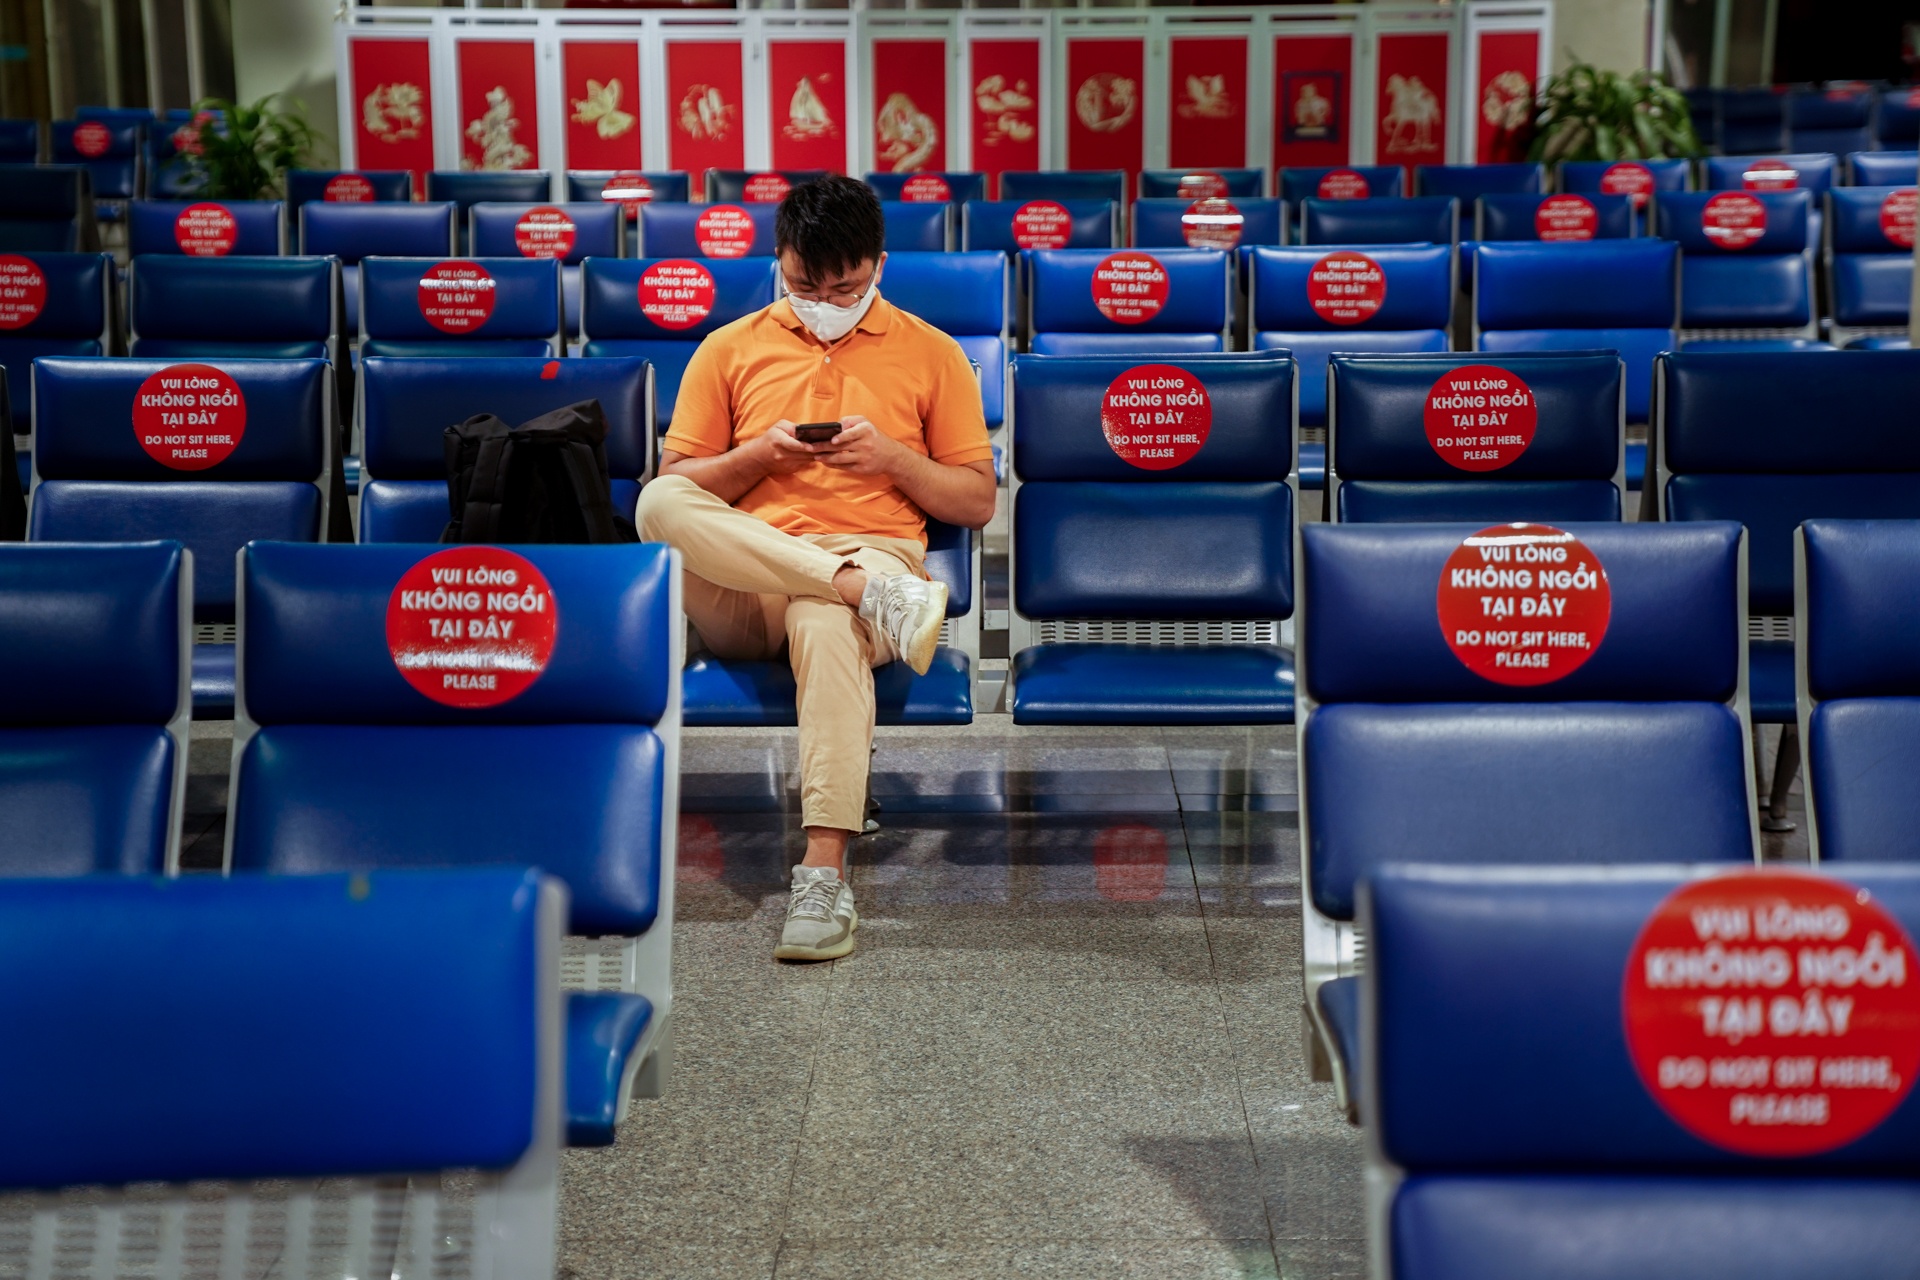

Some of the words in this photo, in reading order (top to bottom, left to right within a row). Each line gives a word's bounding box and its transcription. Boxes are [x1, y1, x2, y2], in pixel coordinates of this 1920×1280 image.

[1111, 260, 1126, 268] VUI
[1327, 261, 1341, 269] VUI
[644, 275, 681, 287] KHÔNG
[1098, 268, 1135, 281] KHÔNG
[1313, 270, 1351, 281] KHÔNG
[656, 290, 672, 301] TẠI
[1110, 283, 1126, 295] TẠI
[1326, 285, 1342, 296] TẠI
[1099, 298, 1111, 306] DO
[663, 314, 688, 322] PLEASE
[1117, 308, 1141, 316] PLEASE
[161, 379, 181, 389] VUI
[185, 376, 219, 389] LÒNG
[1128, 379, 1148, 389] VUI
[1151, 376, 1184, 389] LÒNG
[1451, 381, 1471, 391] VUI
[1474, 377, 1508, 390] LÒNG
[142, 391, 195, 406] KHÔNG
[200, 386, 237, 406] NGỒI
[1110, 391, 1162, 407] KHÔNG
[1166, 386, 1203, 406] NGỒI
[1432, 393, 1485, 409] KHÔNG
[1489, 386, 1527, 407] NGỒI
[161, 413, 183, 428] TẠI
[188, 409, 217, 424] ĐÂY
[1129, 413, 1150, 428] TẠI
[1154, 409, 1184, 424] ĐÂY
[1452, 415, 1474, 430] TẠI
[1478, 410, 1508, 426] ĐÂY
[145, 435, 162, 444] DO
[165, 435, 186, 444] NOT
[189, 435, 203, 444] SIT
[206, 435, 233, 445] HERE,
[1114, 435, 1130, 444] DO
[1132, 435, 1153, 444] NOT
[1156, 435, 1170, 444] SIT
[1173, 434, 1200, 444] HERE,
[1437, 437, 1453, 447] DO
[1456, 437, 1477, 446] NOT
[1480, 436, 1494, 445] SIT
[1497, 435, 1525, 446] HERE,
[172, 449, 207, 458] PLEASE
[1140, 448, 1174, 458] PLEASE
[1464, 450, 1499, 460] PLEASE
[1481, 547, 1511, 561] VUI
[1516, 543, 1567, 562] LÒNG
[431, 569, 461, 584] VUI
[466, 566, 517, 585] LÒNG
[1452, 565, 1532, 588] KHÔNG
[1539, 559, 1596, 589] NGỒI
[401, 586, 481, 611] KHÔNG
[487, 581, 544, 612] NGỒI
[1480, 598, 1513, 620] TẠI
[1520, 593, 1565, 616] ĐÂY
[428, 619, 462, 643] TẠI
[468, 614, 513, 639] ĐÂY
[1456, 631, 1481, 644] DO
[1485, 631, 1517, 645] NOT
[1522, 632, 1543, 646] SIT
[1548, 632, 1590, 648] HERE,
[1497, 652, 1549, 667] PLEASE
[442, 674, 496, 690] PLEASE
[1693, 909, 1751, 939] VUI
[1755, 902, 1851, 938] LÒNG
[1644, 942, 1791, 986] KHÔNG
[1797, 928, 1904, 985] NGỒI
[1698, 1000, 1761, 1043] TẠI
[1767, 990, 1853, 1034] ĐÂY
[1659, 1059, 1706, 1086] DO
[1709, 1059, 1771, 1086] NOT
[1774, 1059, 1817, 1086] SIT
[1821, 1059, 1899, 1089] HERE,
[1732, 1095, 1829, 1124] PLEASE
